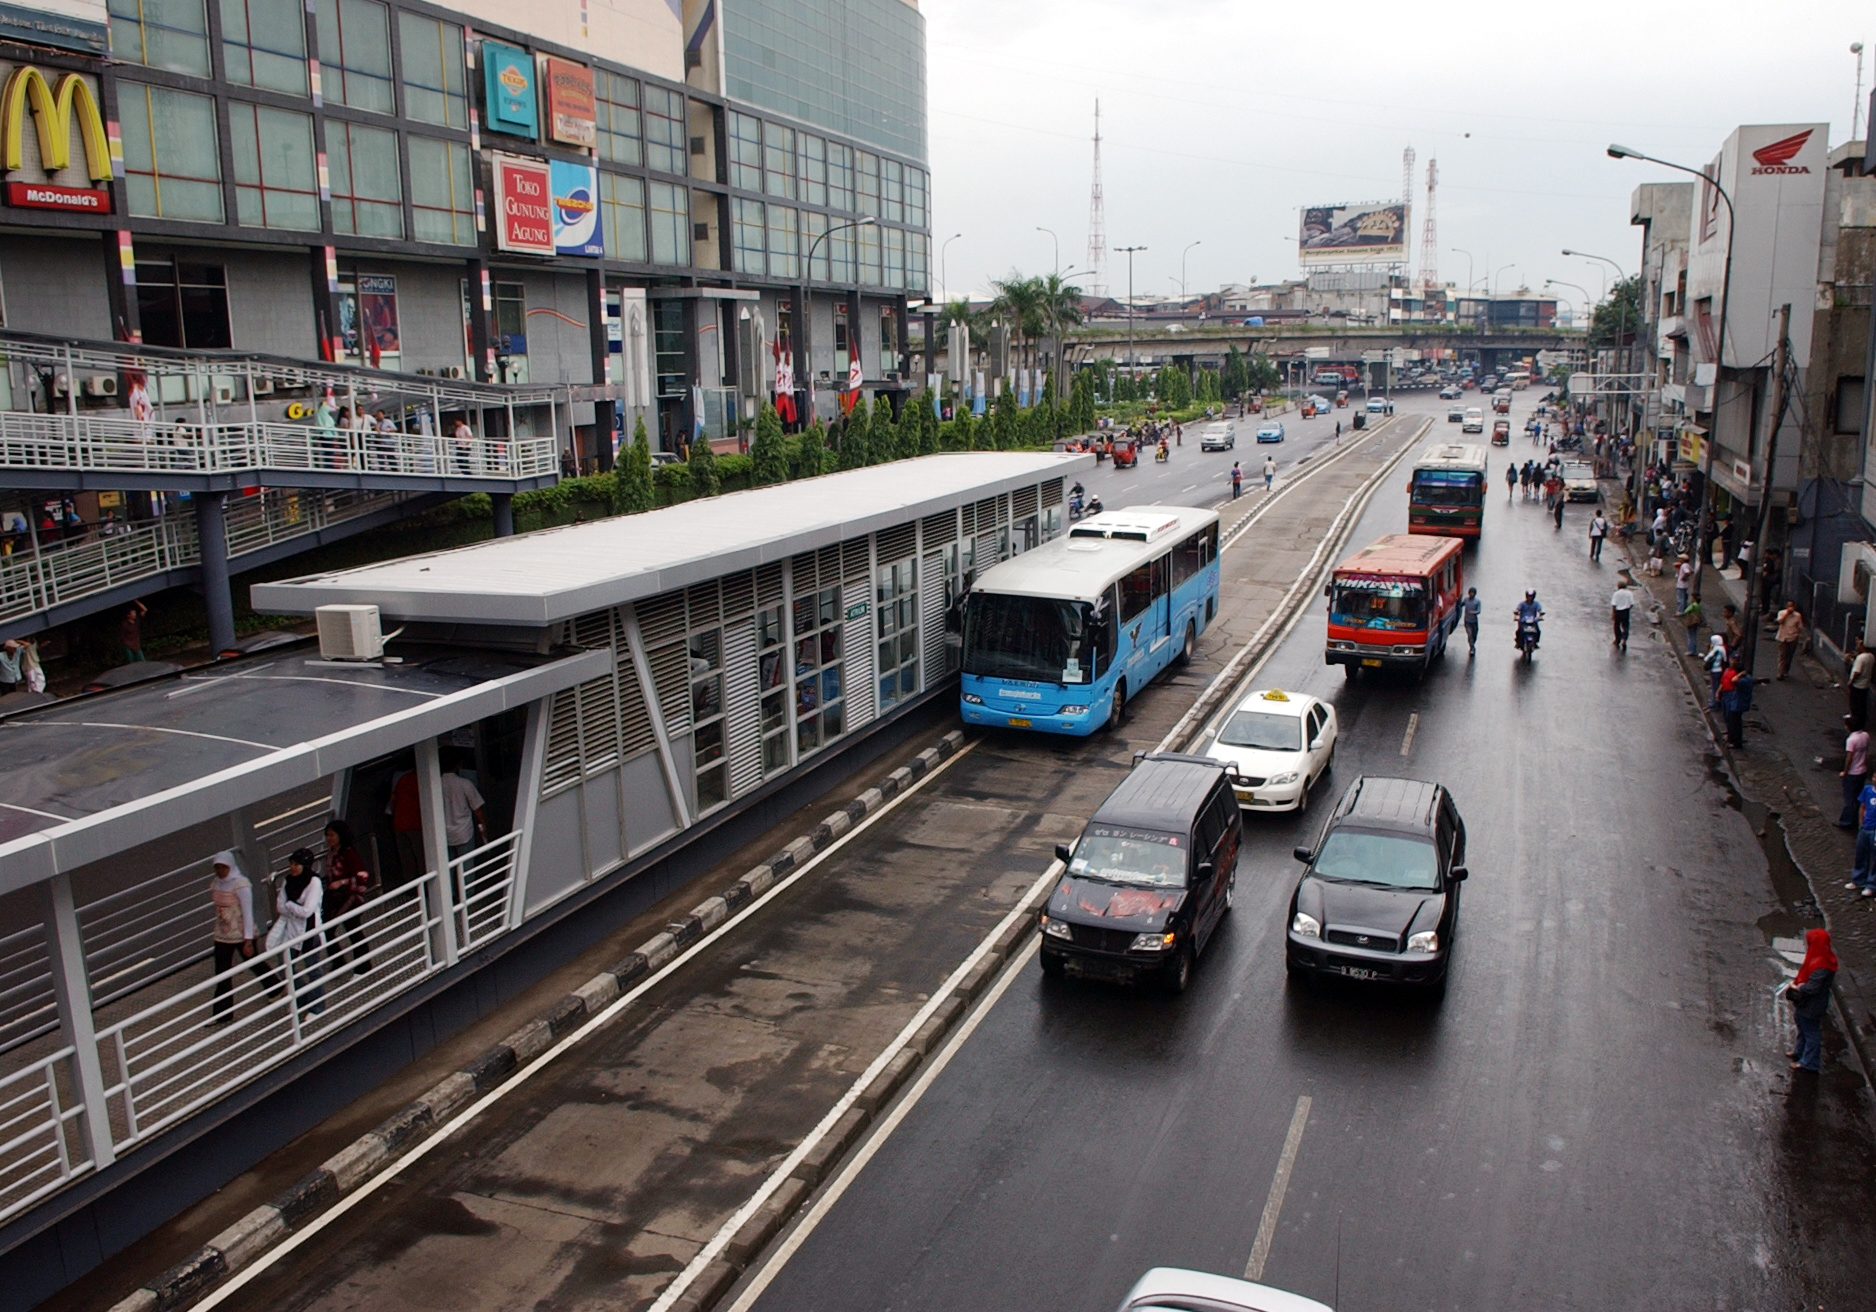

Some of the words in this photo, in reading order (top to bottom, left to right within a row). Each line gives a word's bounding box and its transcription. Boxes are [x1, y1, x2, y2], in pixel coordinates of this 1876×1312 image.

[1750, 166, 1811, 175] HONDA
[513, 174, 540, 196] TOKO
[27, 190, 98, 206] McDonald's
[505, 197, 549, 220] GUNUNG
[512, 222, 547, 242] AGUNG
